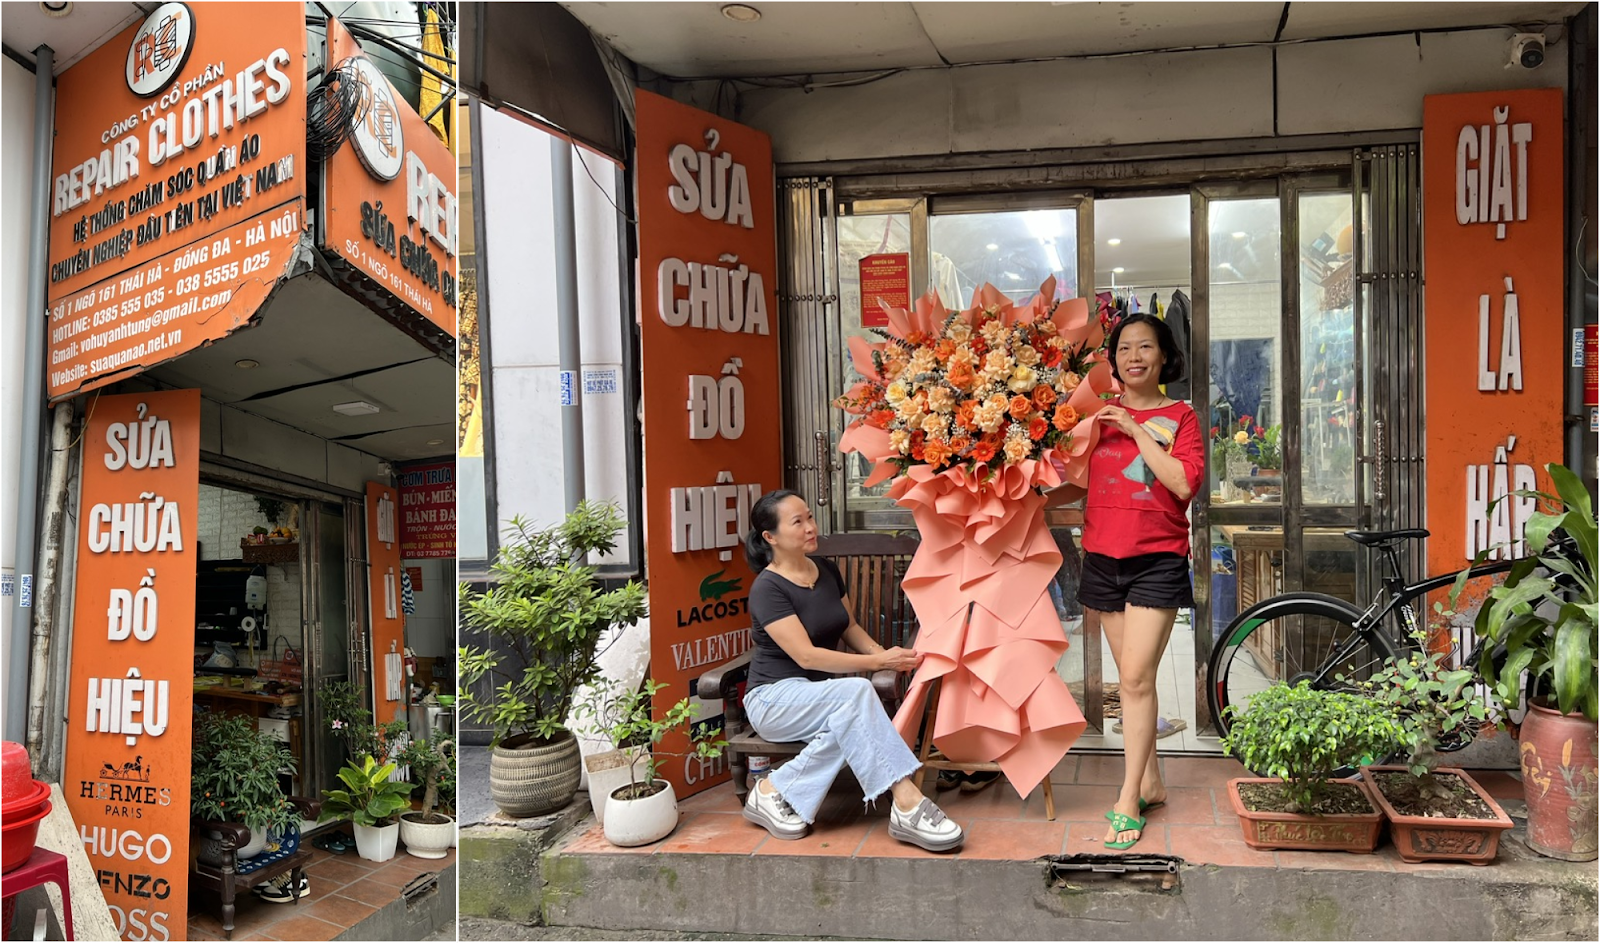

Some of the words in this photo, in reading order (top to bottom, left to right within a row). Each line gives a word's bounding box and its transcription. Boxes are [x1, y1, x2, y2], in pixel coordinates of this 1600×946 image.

[53, 134, 140, 217] REPAIR
[148, 47, 291, 166] CLOTHES
[101, 114, 139, 144] CÔNG
[140, 101, 157, 122] TY
[184, 61, 224, 96] PHẦN
[74, 217, 88, 242] HỆ
[90, 198, 126, 236] THỐNG
[128, 180, 164, 216] CHĂM
[167, 162, 194, 198] SÓC
[197, 144, 237, 186] QUẦN
[240, 133, 261, 165] ÁO
[668, 128, 755, 229] SỬA
[1456, 105, 1532, 240] GIẶT
[51, 246, 92, 283] CHUYÊN
[93, 228, 134, 261] NGHIỆP
[136, 212, 162, 247] ĐẦU
[197, 187, 220, 222] TẠI
[221, 173, 254, 207] VIỆT
[255, 153, 294, 195] NAM
[360, 200, 397, 259] SỬA
[52, 316, 91, 344] HOTLINE:
[92, 304, 118, 328] 0385
[120, 298, 142, 320] 555
[144, 286, 165, 310] 035
[176, 274, 200, 297] 038
[204, 264, 239, 288] 5555
[242, 250, 270, 275] 025
[53, 299, 66, 322] SỐ
[67, 302, 73, 314] 1
[74, 289, 96, 314] NGÕ
[98, 286, 116, 304] 161
[119, 272, 144, 298] THÁI
[146, 262, 162, 286] HÀ
[172, 245, 208, 274] ĐỐNG
[212, 237, 231, 260] ĐA
[244, 220, 266, 248] HÀ
[270, 210, 298, 240] NỘI
[345, 238, 360, 259] SỐ
[362, 251, 366, 265] 1
[368, 256, 388, 282] NGÕ
[389, 272, 402, 293] 161
[404, 282, 422, 308] THÁI
[422, 293, 433, 314] HÀ
[658, 253, 770, 336] CHỮA
[52, 344, 79, 365] Gmail:
[80, 288, 232, 353] vohuyanhtung@gmail.com
[52, 365, 88, 388] Website:
[90, 328, 182, 376] suaquanao.net.vn
[1477, 276, 1523, 392] LÀ
[686, 357, 746, 440] ĐỒ
[104, 402, 177, 472] SỬA
[402, 489, 425, 506] BÚN
[426, 466, 452, 485] TRƯA
[1465, 434, 1537, 561] HẤP
[87, 491, 184, 555] CHỮA
[406, 507, 437, 524] BÁNH
[440, 508, 456, 522] ĐA
[670, 470, 762, 562] HIỆU
[107, 568, 160, 643] ĐỒ
[677, 597, 749, 628] LACOST
[86, 666, 170, 747] HIỆU
[80, 780, 171, 806] HERMES
[105, 804, 142, 819] PARIS
[80, 824, 172, 865] HUGO
[97, 870, 171, 900] ENZO
[107, 904, 170, 941] OSS
